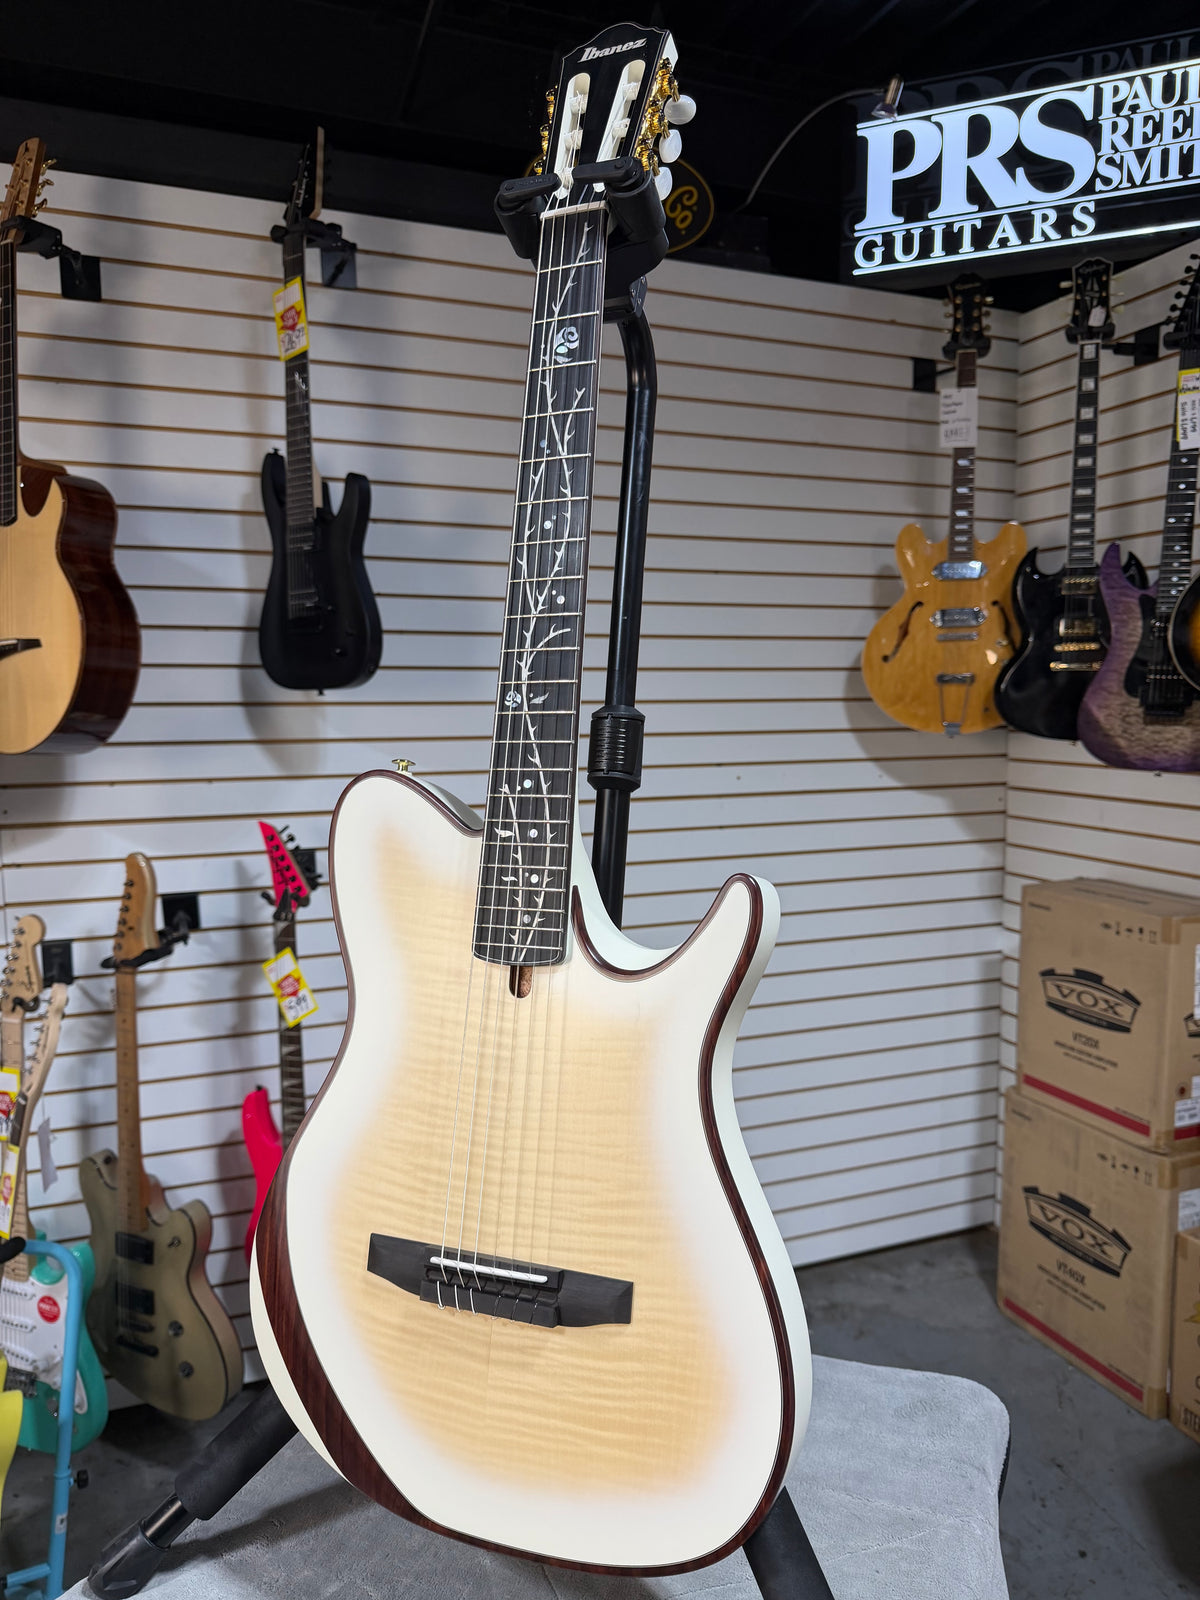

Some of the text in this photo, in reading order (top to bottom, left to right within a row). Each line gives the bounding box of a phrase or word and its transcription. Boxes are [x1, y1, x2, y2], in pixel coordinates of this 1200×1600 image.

[577, 37, 648, 63] Ibanez
[854, 84, 1096, 230] PRS
[1097, 103, 1200, 156] REE
[854, 200, 1096, 268] GUITARS
[1053, 984, 1124, 1018] VOX
[1037, 1203, 1114, 1260] VOX
